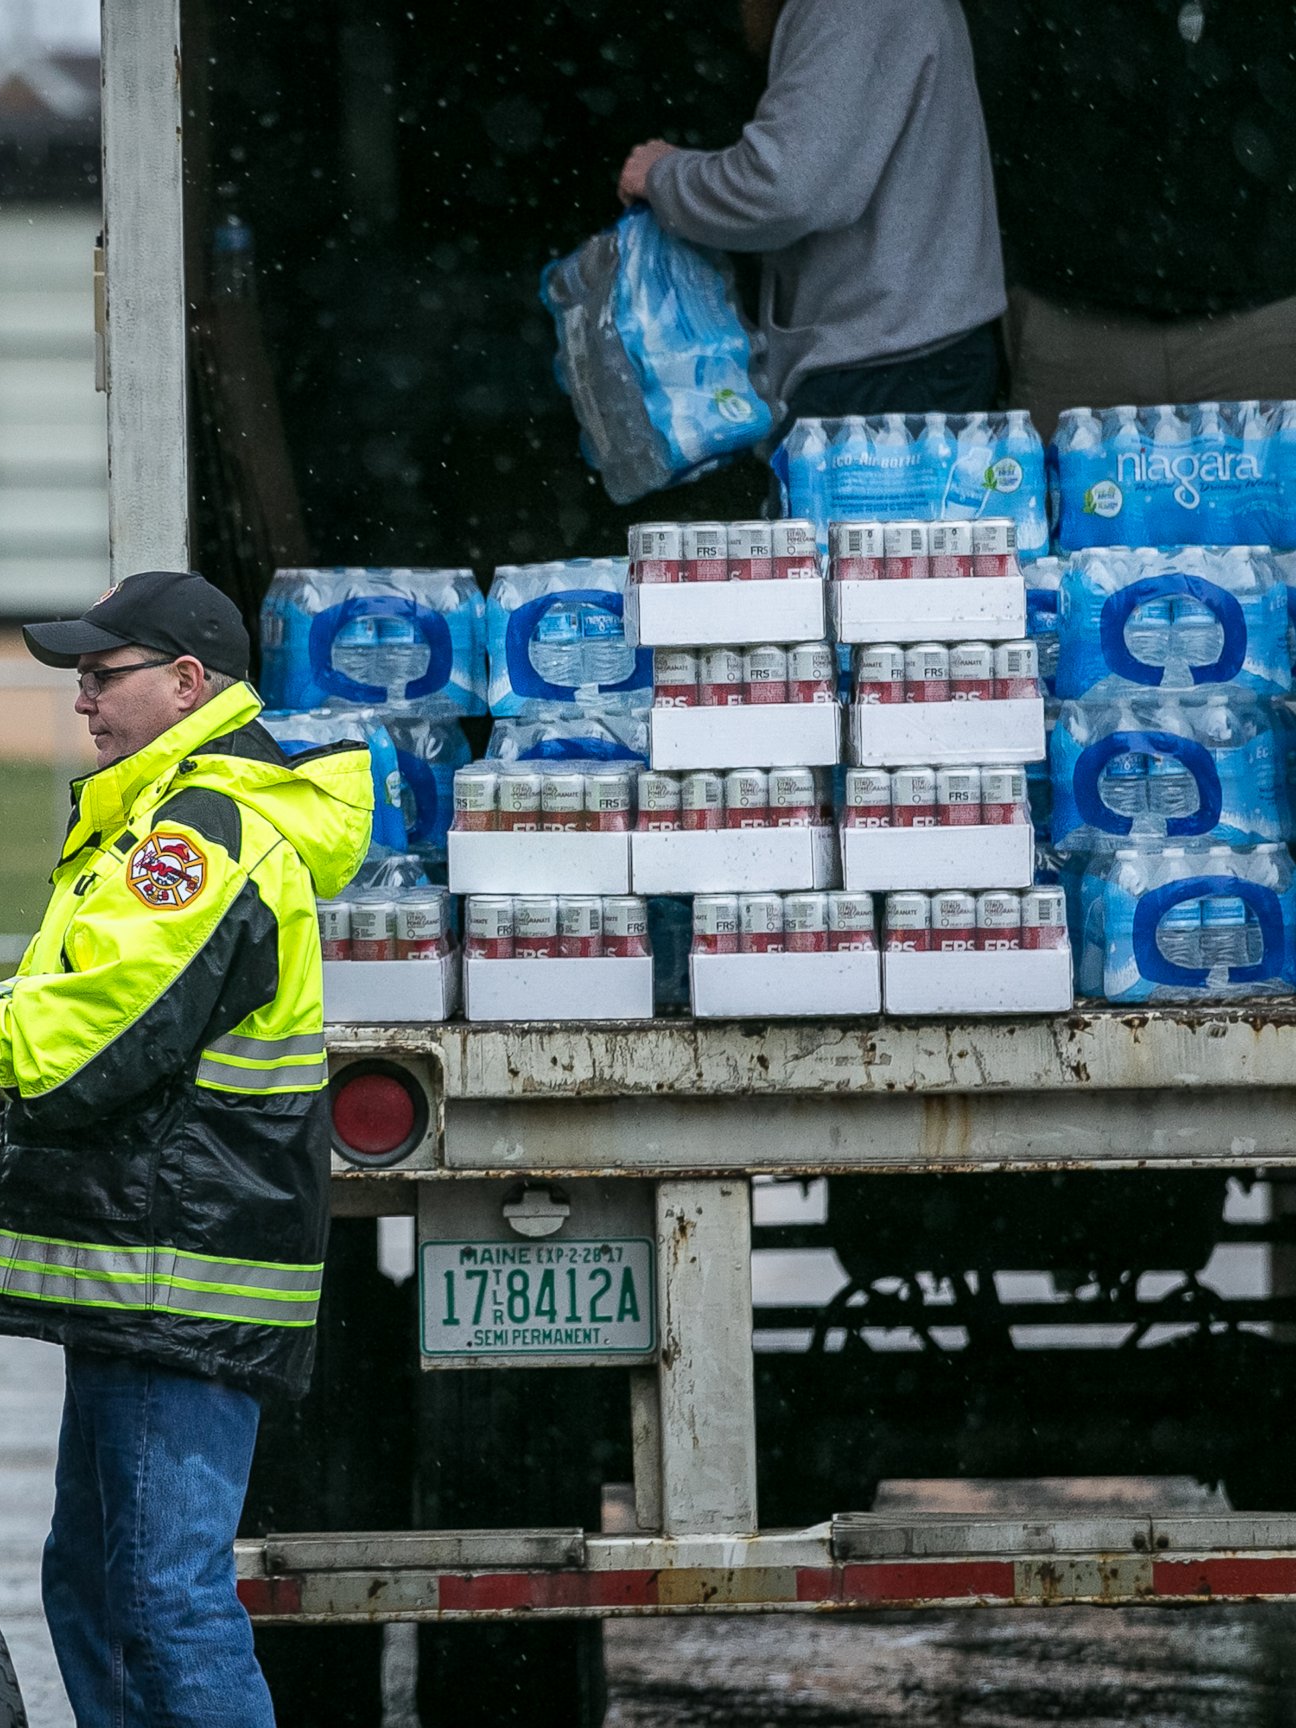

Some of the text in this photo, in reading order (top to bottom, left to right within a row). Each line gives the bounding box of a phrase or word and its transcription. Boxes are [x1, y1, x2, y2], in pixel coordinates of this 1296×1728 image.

[1117, 447, 1262, 510] niagara
[697, 546, 717, 556] FRS
[750, 545, 769, 555] FRS
[750, 669, 770, 679] FRS
[924, 667, 943, 677] FRS
[949, 791, 969, 801] FRS
[599, 798, 619, 808] FRS
[627, 923, 645, 933] FRS
[716, 921, 736, 931] FRS
[459, 1247, 531, 1265] MAINE
[506, 1266, 641, 1324] 8412A
[474, 1327, 600, 1346] SEMI PERMANENT
